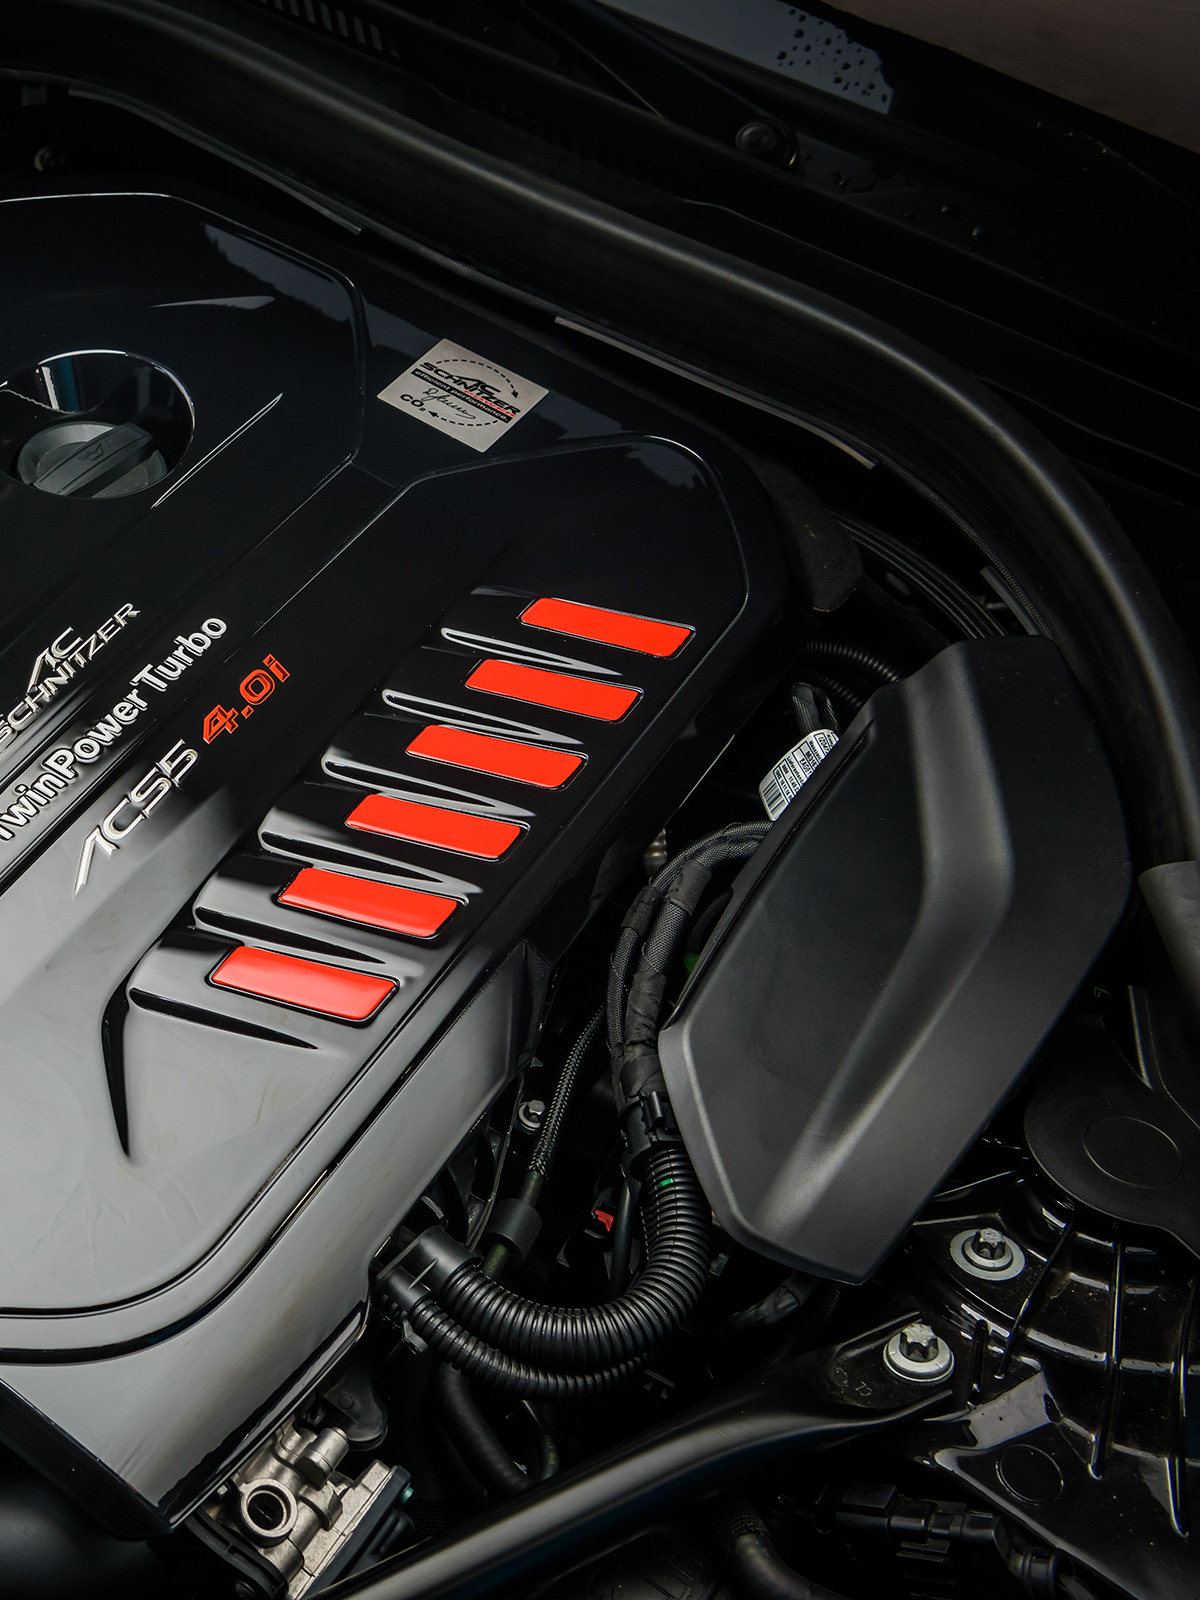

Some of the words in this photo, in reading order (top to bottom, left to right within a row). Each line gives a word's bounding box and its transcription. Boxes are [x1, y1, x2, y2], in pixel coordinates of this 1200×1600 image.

[414, 369, 451, 393] efficient
[452, 387, 510, 422] performance.
[420, 361, 522, 416] SCHNITZER
[463, 389, 516, 418] POWER
[130, 617, 228, 692] Turbo
[73, 738, 199, 899] ACS5
[202, 653, 291, 745] 4.0i
